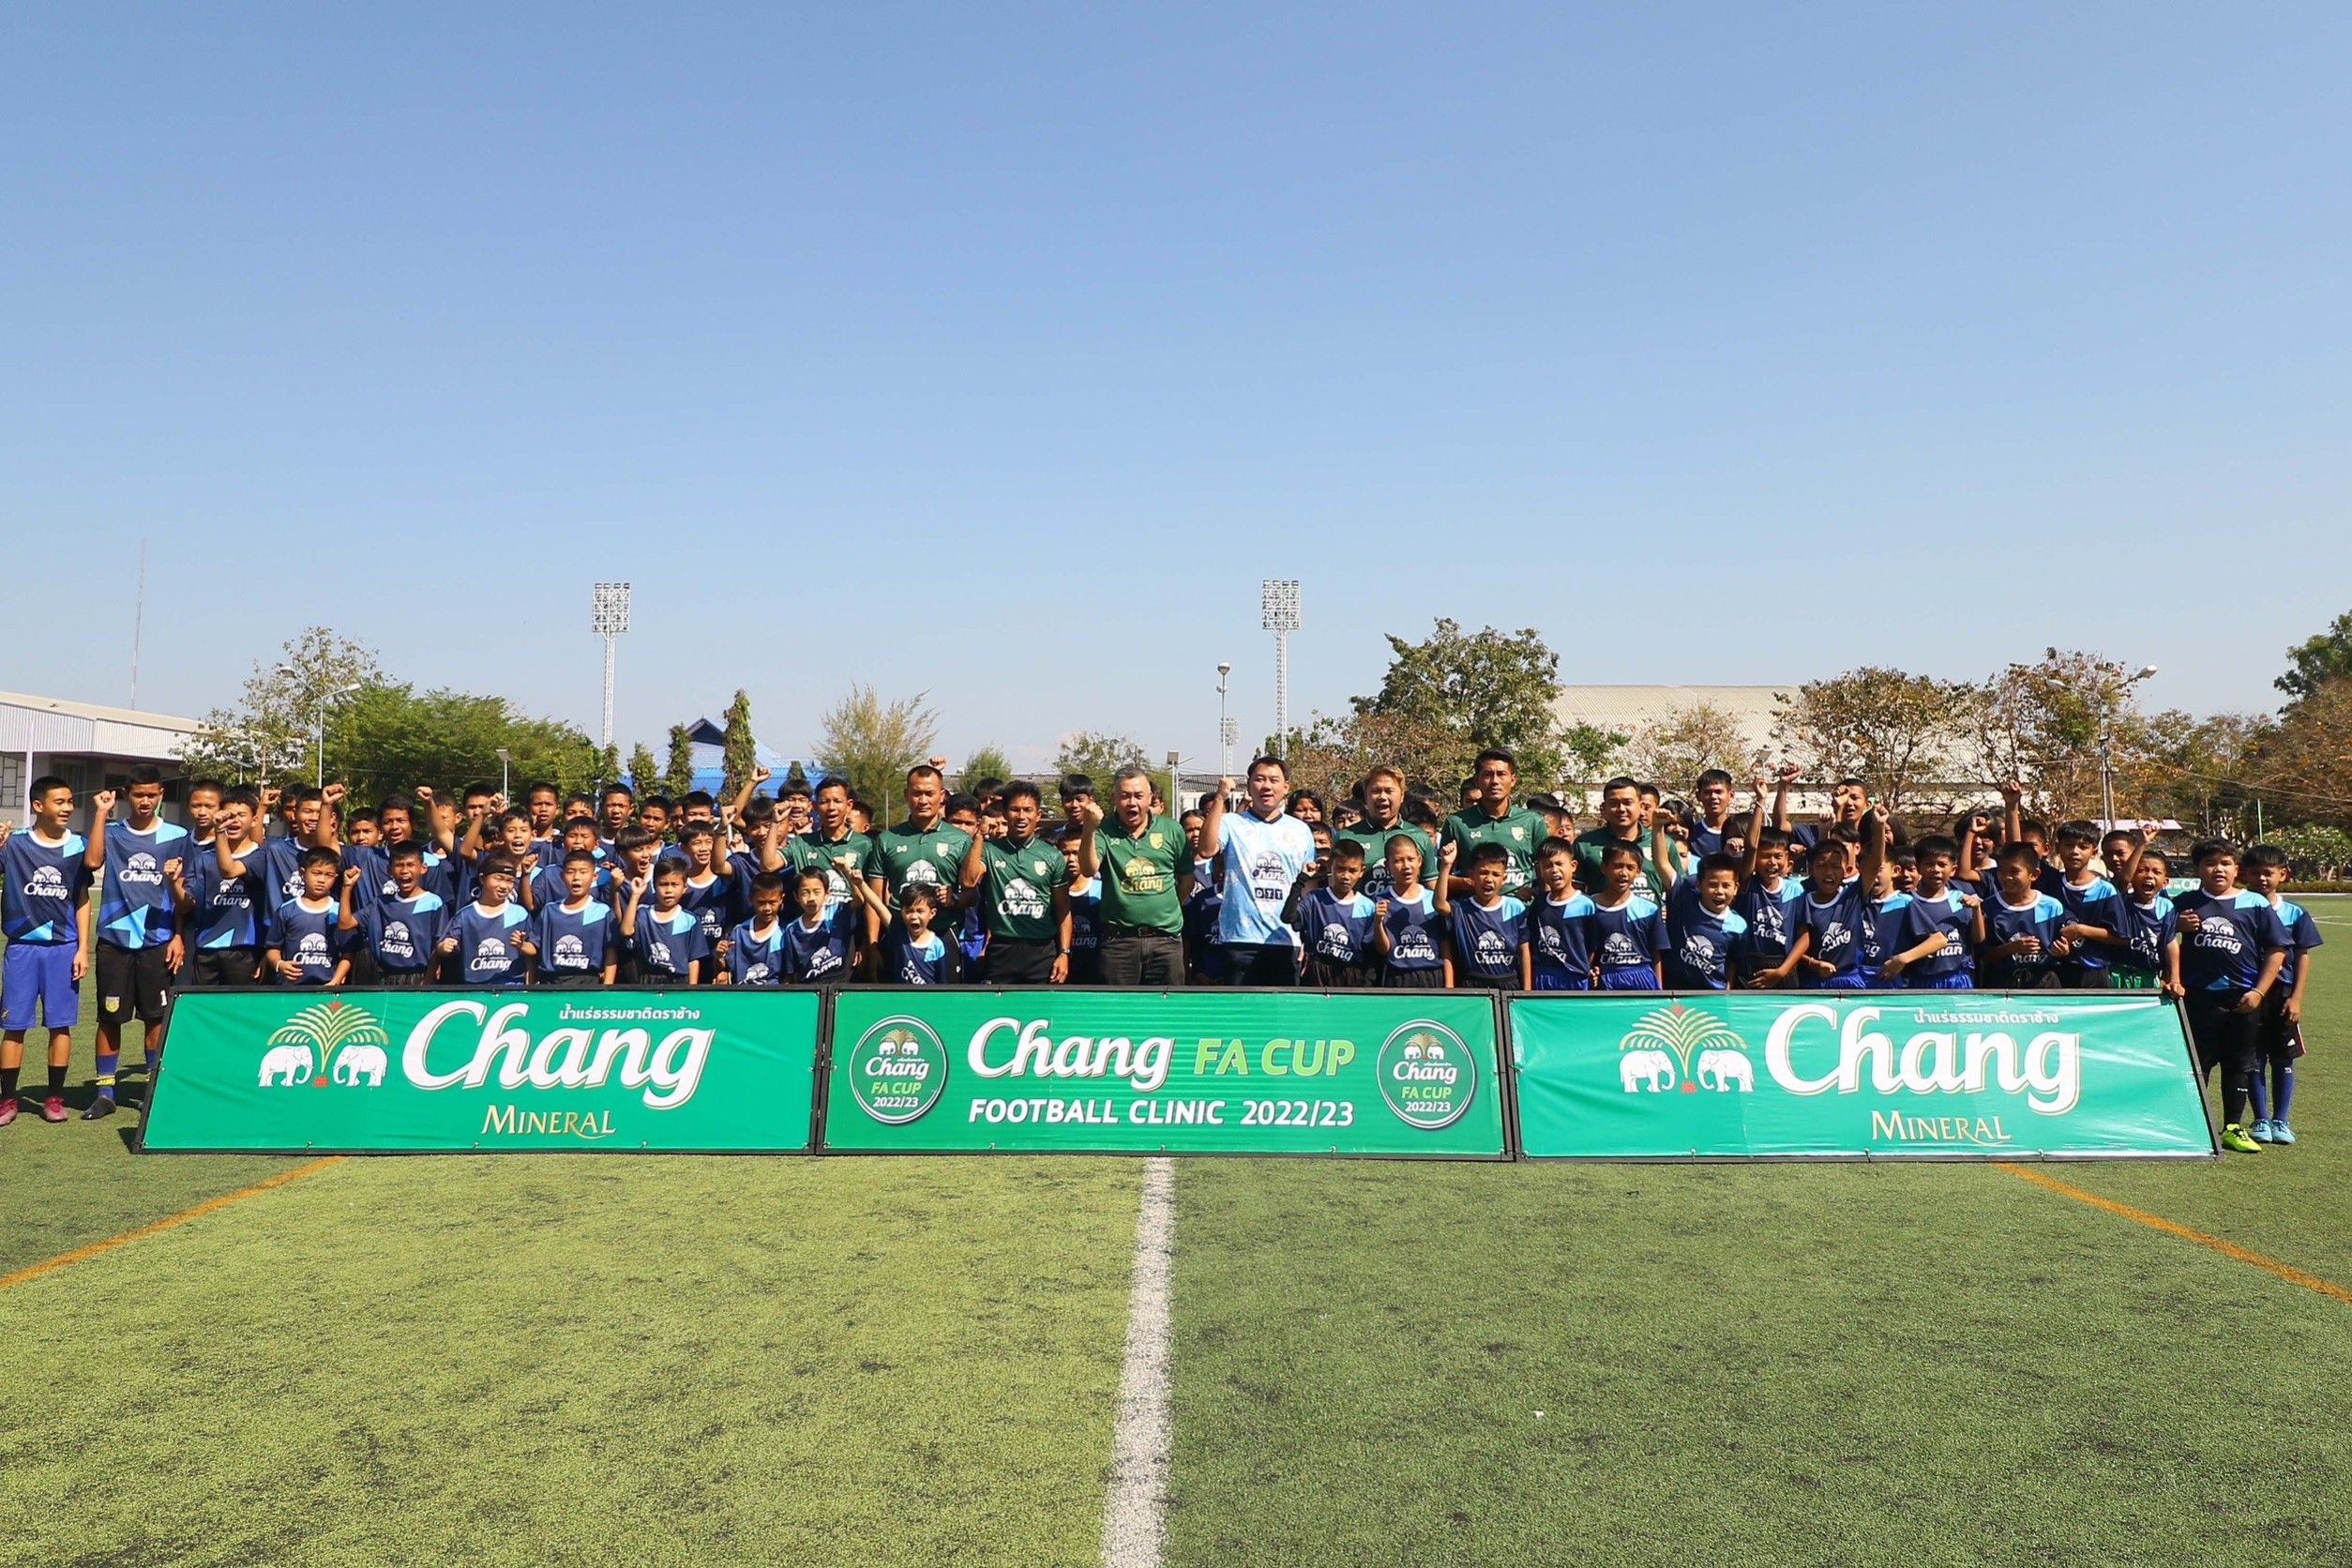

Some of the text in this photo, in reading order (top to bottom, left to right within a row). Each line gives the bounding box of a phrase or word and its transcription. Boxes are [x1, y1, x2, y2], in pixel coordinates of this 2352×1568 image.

[119, 868, 163, 886] Chang
[1121, 875, 1164, 892] Chang
[23, 882, 68, 900] Chang
[213, 894, 249, 909] Chang
[998, 900, 1045, 919] Chang
[1315, 940, 1353, 962] Chang
[1394, 945, 1436, 960] Chang
[2194, 932, 2242, 955] Chang
[471, 957, 512, 972] Chang
[1473, 950, 1515, 966] Chang
[559, 1003, 701, 1020] น้ำแร่ธรรมชาติตราช้าง
[402, 1000, 716, 1111] Chang
[967, 1017, 1357, 1093] Chang FA CUP
[1764, 1004, 2081, 1116] Chang
[865, 1057, 930, 1080] Chang
[1393, 1061, 1458, 1085] Chang
[871, 1081, 923, 1094] FA CUP
[1401, 1086, 1453, 1099] FA CUP
[872, 1096, 919, 1108] 2022/23
[1405, 1101, 1452, 1113] 2022/23
[968, 1098, 1354, 1127] FOOTBALL CLINIC 2022/23
[480, 1105, 616, 1140] MINERAL
[1871, 1110, 2013, 1146] MINERAL
